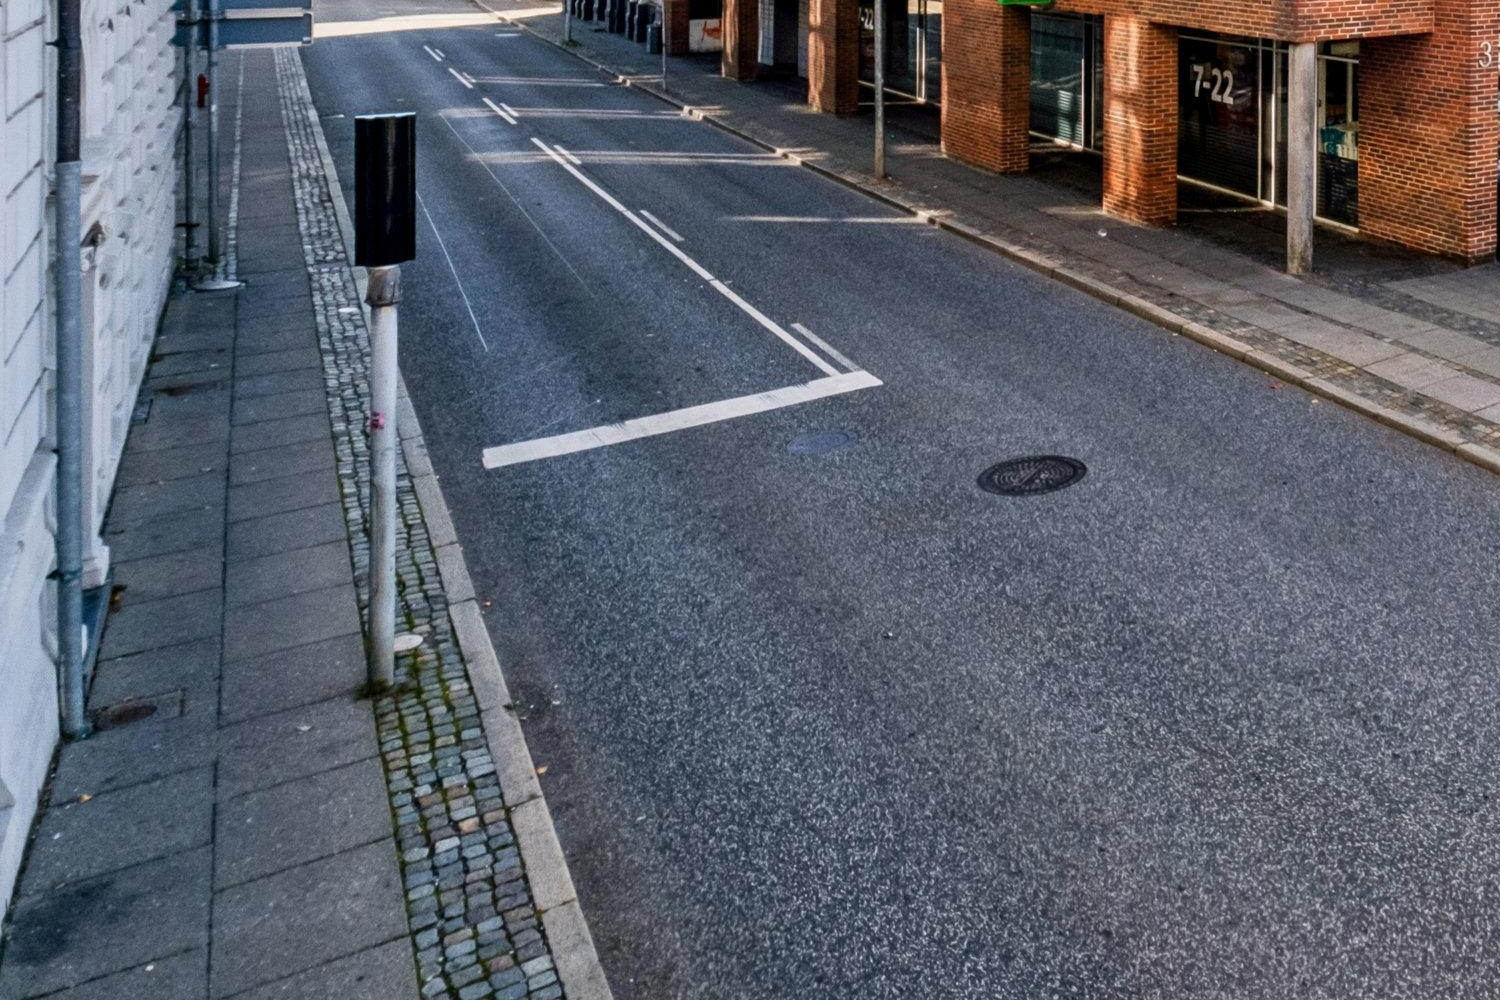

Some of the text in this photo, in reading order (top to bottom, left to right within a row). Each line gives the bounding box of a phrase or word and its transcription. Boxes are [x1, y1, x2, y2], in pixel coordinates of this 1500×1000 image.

[860, 7, 874, 30] -22
[1479, 41, 1492, 68] 3
[1193, 64, 1234, 105] 7-22
